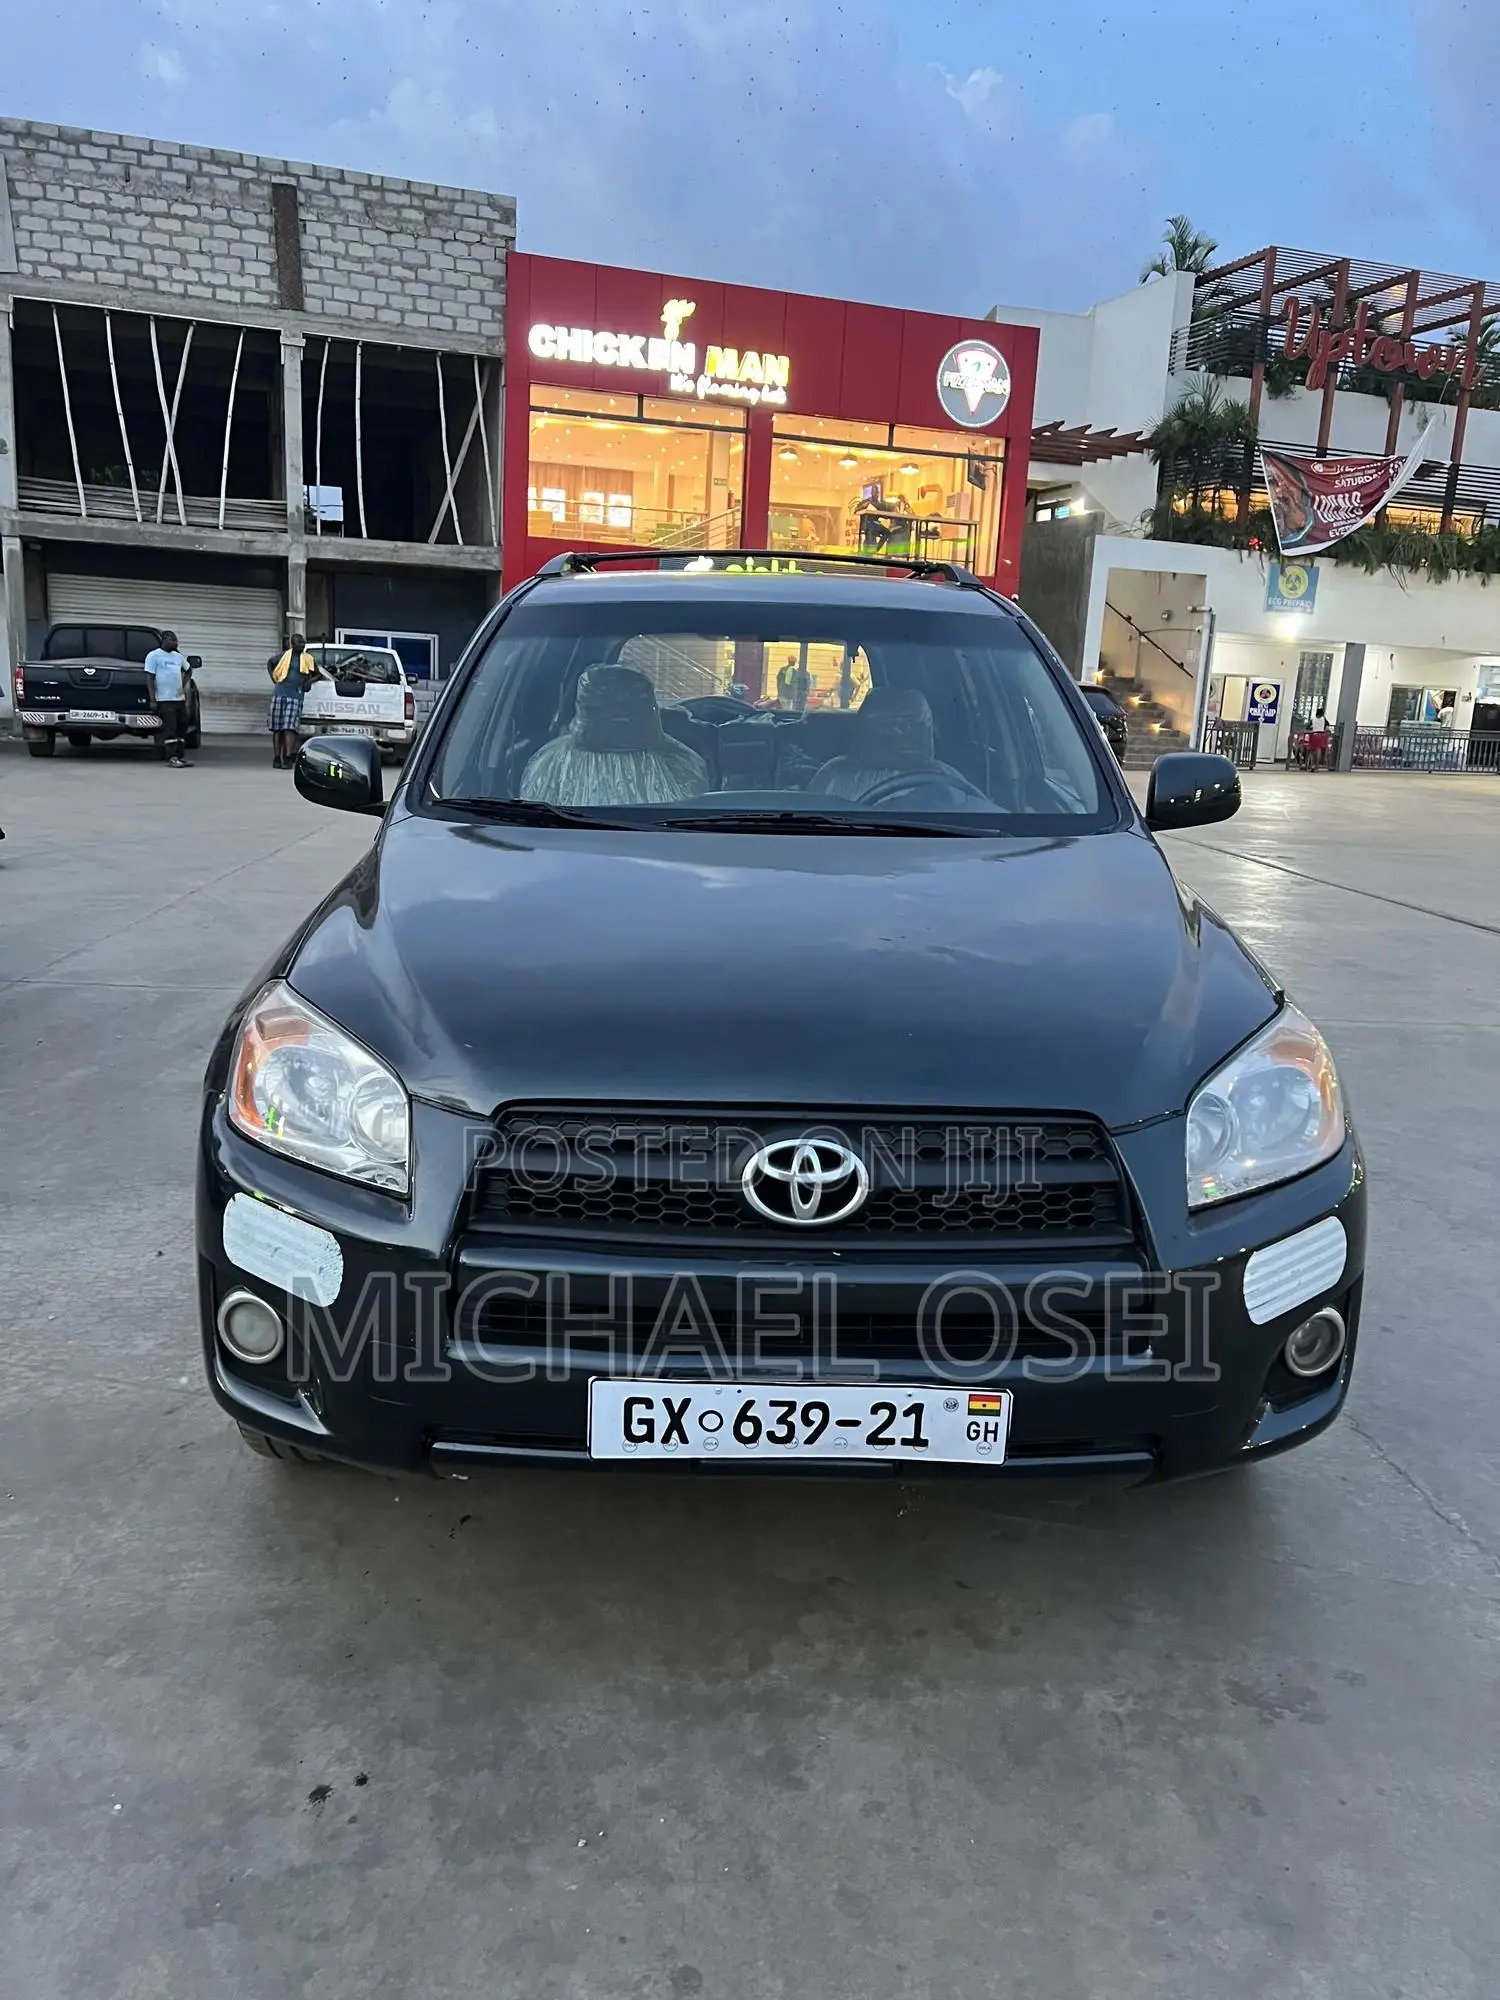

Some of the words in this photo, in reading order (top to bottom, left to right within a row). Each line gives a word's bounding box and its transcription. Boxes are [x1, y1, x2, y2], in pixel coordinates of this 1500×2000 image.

[528, 324, 696, 374] CHICKEN
[705, 345, 789, 387] MAN
[1282, 295, 1488, 391] Uptown
[316, 701, 381, 715] NISSAN
[1249, 707, 1277, 717] PREPAID
[623, 1396, 692, 1445] GX
[732, 1398, 930, 1448] 639-21
[966, 1421, 999, 1443] GH
